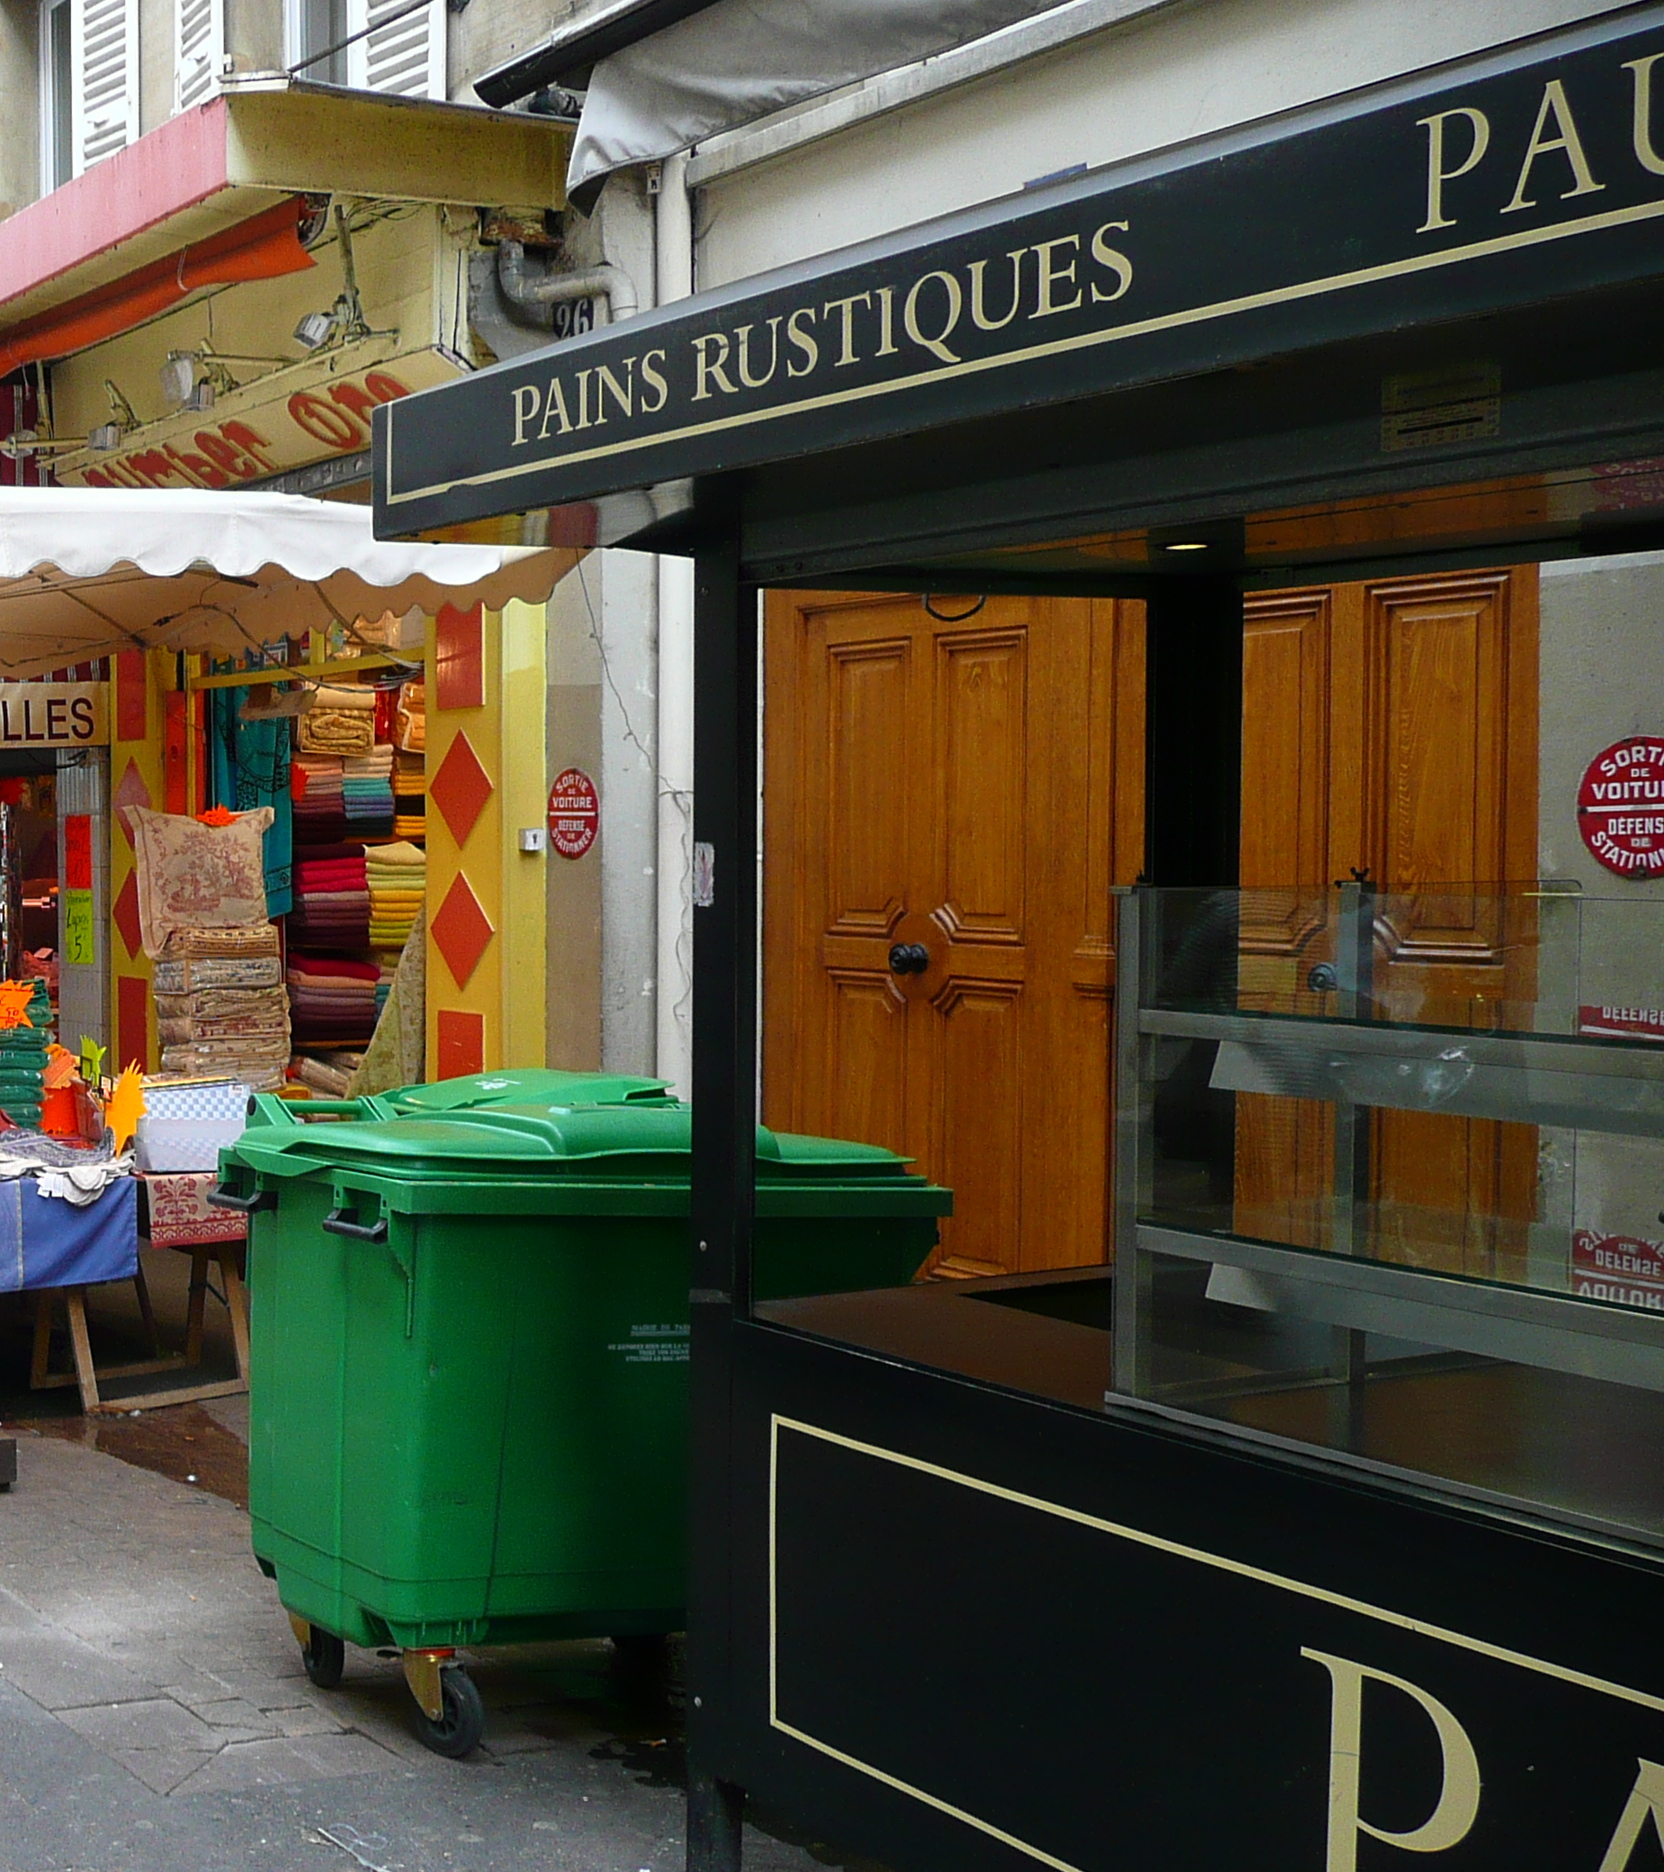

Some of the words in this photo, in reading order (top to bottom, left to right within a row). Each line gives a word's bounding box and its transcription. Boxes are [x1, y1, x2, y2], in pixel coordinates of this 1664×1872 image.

[510, 349, 669, 446] PAINS
[690, 219, 1134, 403] RUSTIQUES
[1630, 768, 1651, 777] DE
[556, 774, 589, 793] SORTIE
[1591, 781, 1664, 800] VOITU
[552, 796, 593, 808] VOITURE
[551, 828, 593, 854] STATIONNER
[1631, 837, 1652, 847] DE
